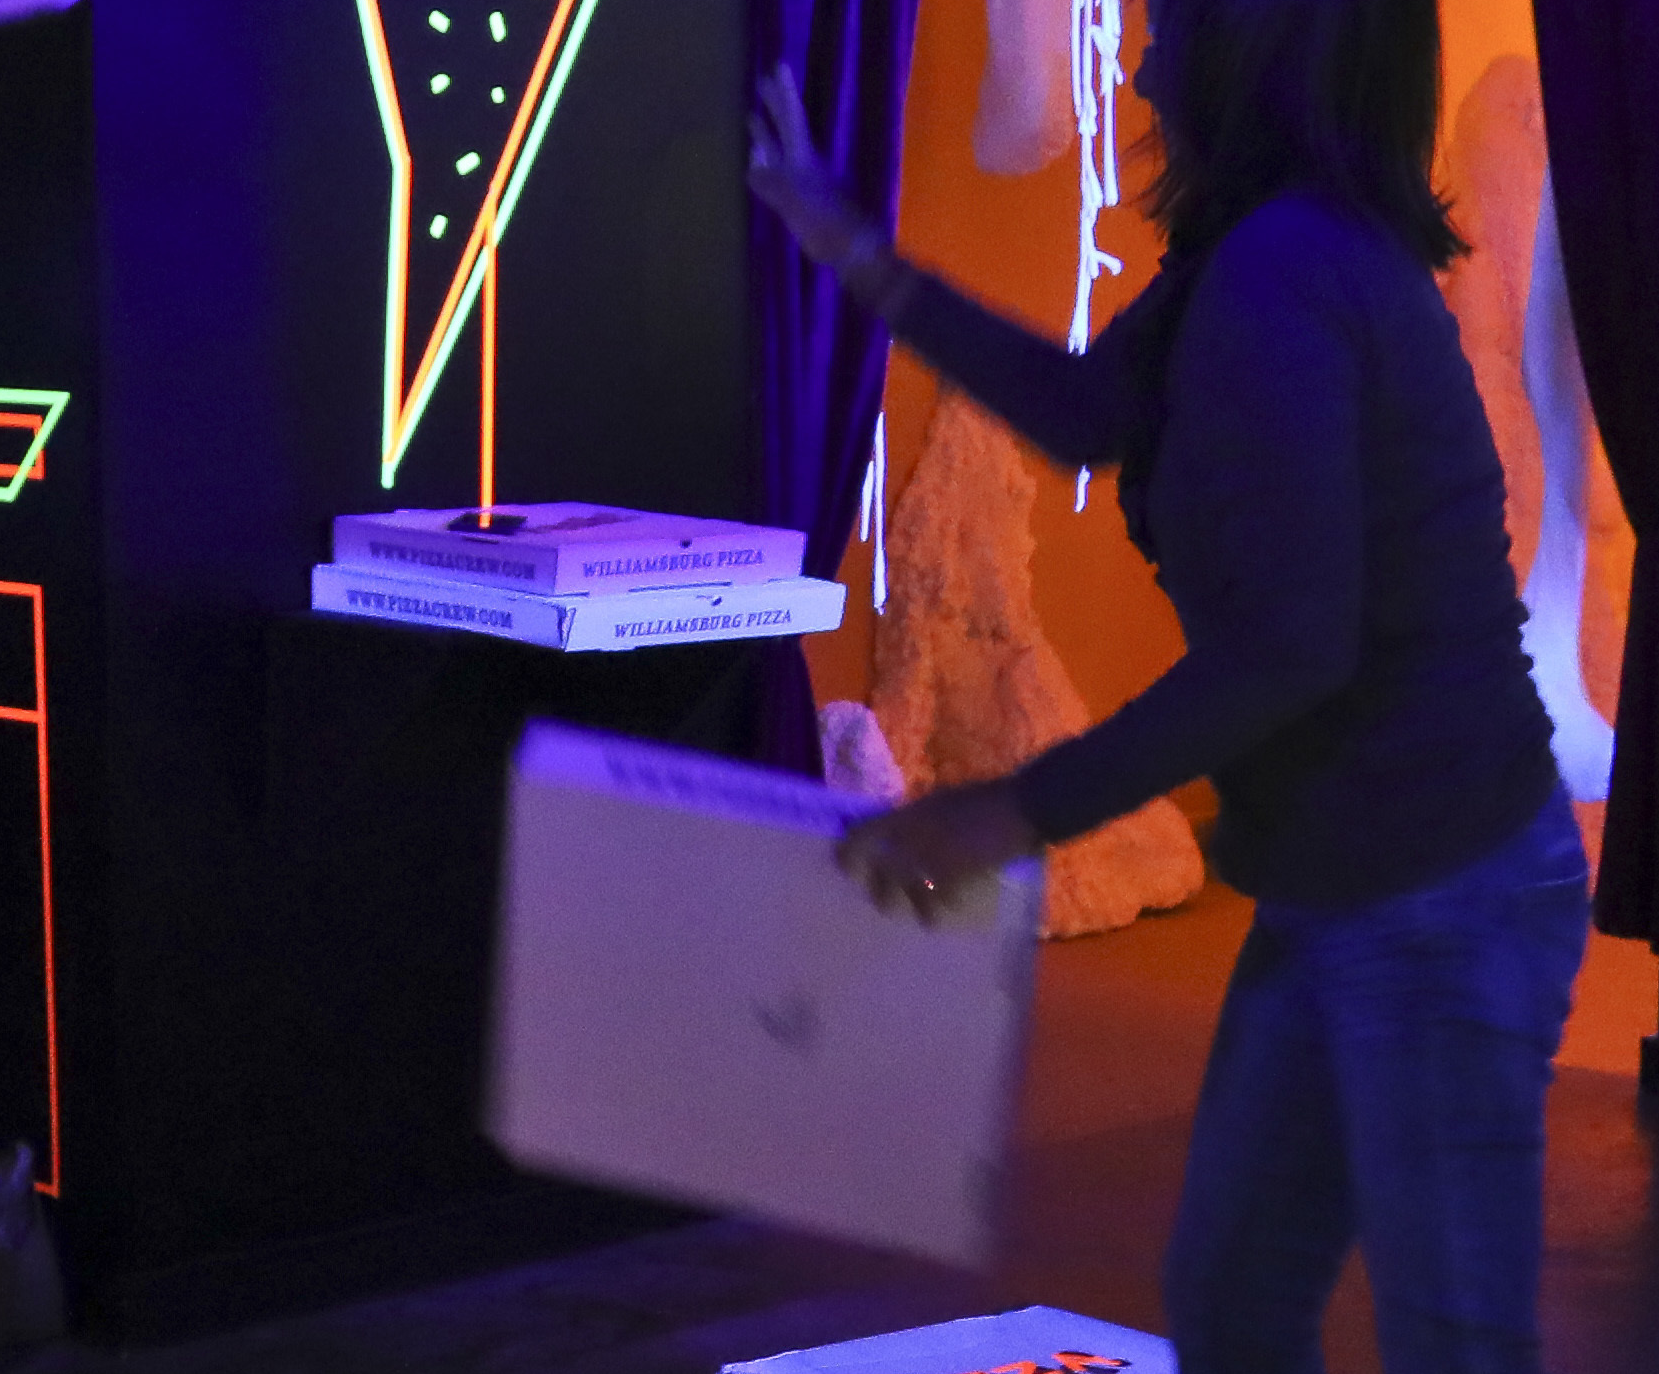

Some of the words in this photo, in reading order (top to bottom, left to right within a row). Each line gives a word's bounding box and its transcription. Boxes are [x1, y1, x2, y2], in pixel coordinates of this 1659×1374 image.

[583, 552, 712, 577] WILLIAMSBURG
[718, 548, 764, 567] PIZZA
[614, 613, 741, 638] WILLIAMSBURG
[746, 608, 792, 627] PIZZA
